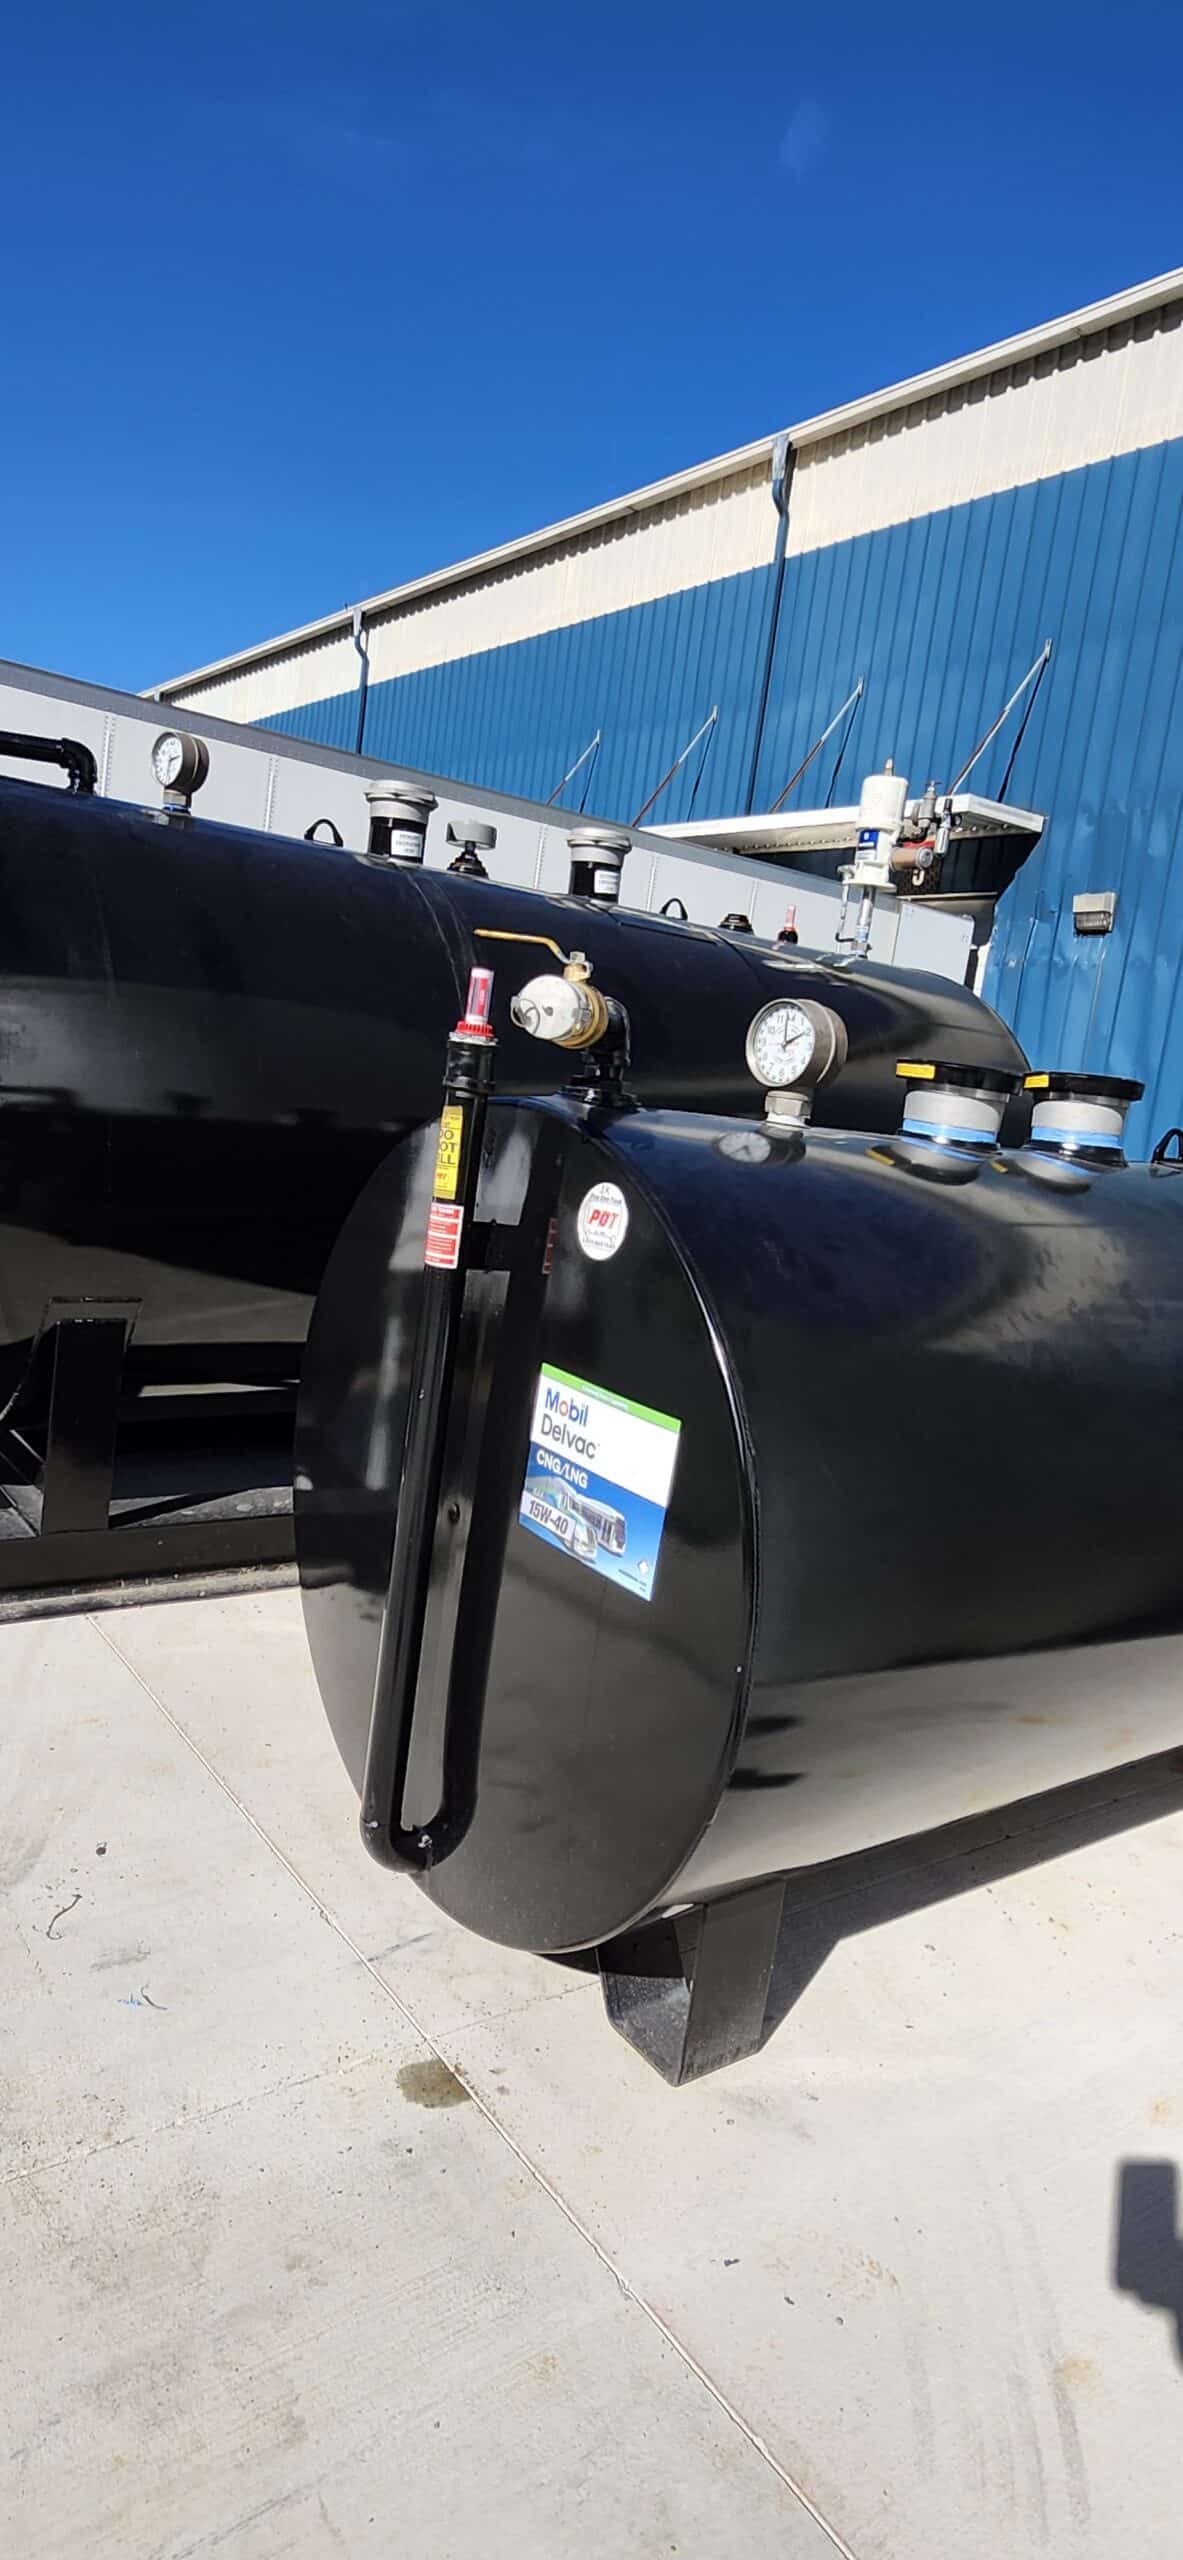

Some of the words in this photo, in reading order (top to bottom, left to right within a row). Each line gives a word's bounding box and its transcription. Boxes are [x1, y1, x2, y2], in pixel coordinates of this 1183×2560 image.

[440, 1141, 458, 1154] OT
[544, 1387, 589, 1427] Mobil
[540, 1413, 597, 1460] Delvac
[535, 1449, 589, 1489] CNG/LNG
[528, 1498, 570, 1535] 15W-40
